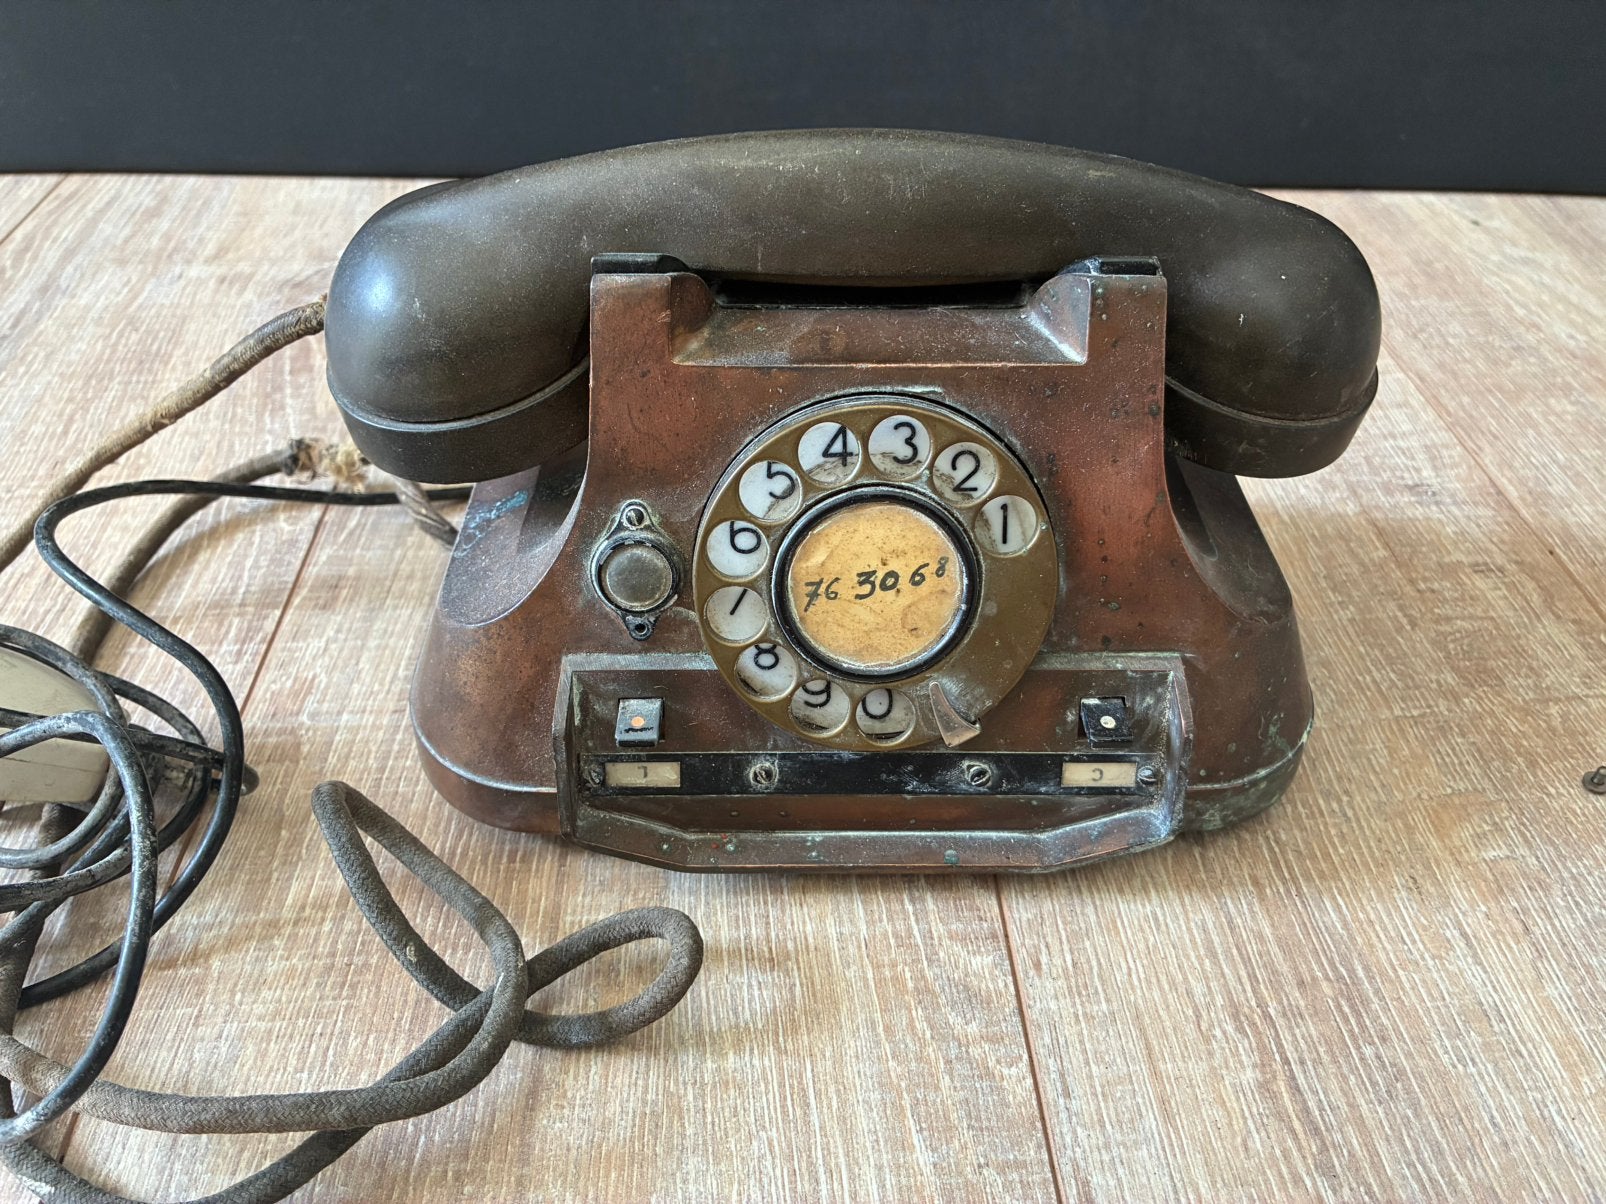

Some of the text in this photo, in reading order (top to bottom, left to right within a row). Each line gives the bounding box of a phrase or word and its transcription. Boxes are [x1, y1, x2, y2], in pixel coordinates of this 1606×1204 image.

[822, 425, 853, 467] 4
[893, 421, 919, 465] 3
[766, 460, 796, 500] 5
[950, 449, 981, 493] 2
[729, 520, 762, 555] 6
[1000, 503, 1008, 545] 1
[804, 577, 841, 612] 76
[754, 643, 780, 670] 8
[802, 680, 831, 709] 9
